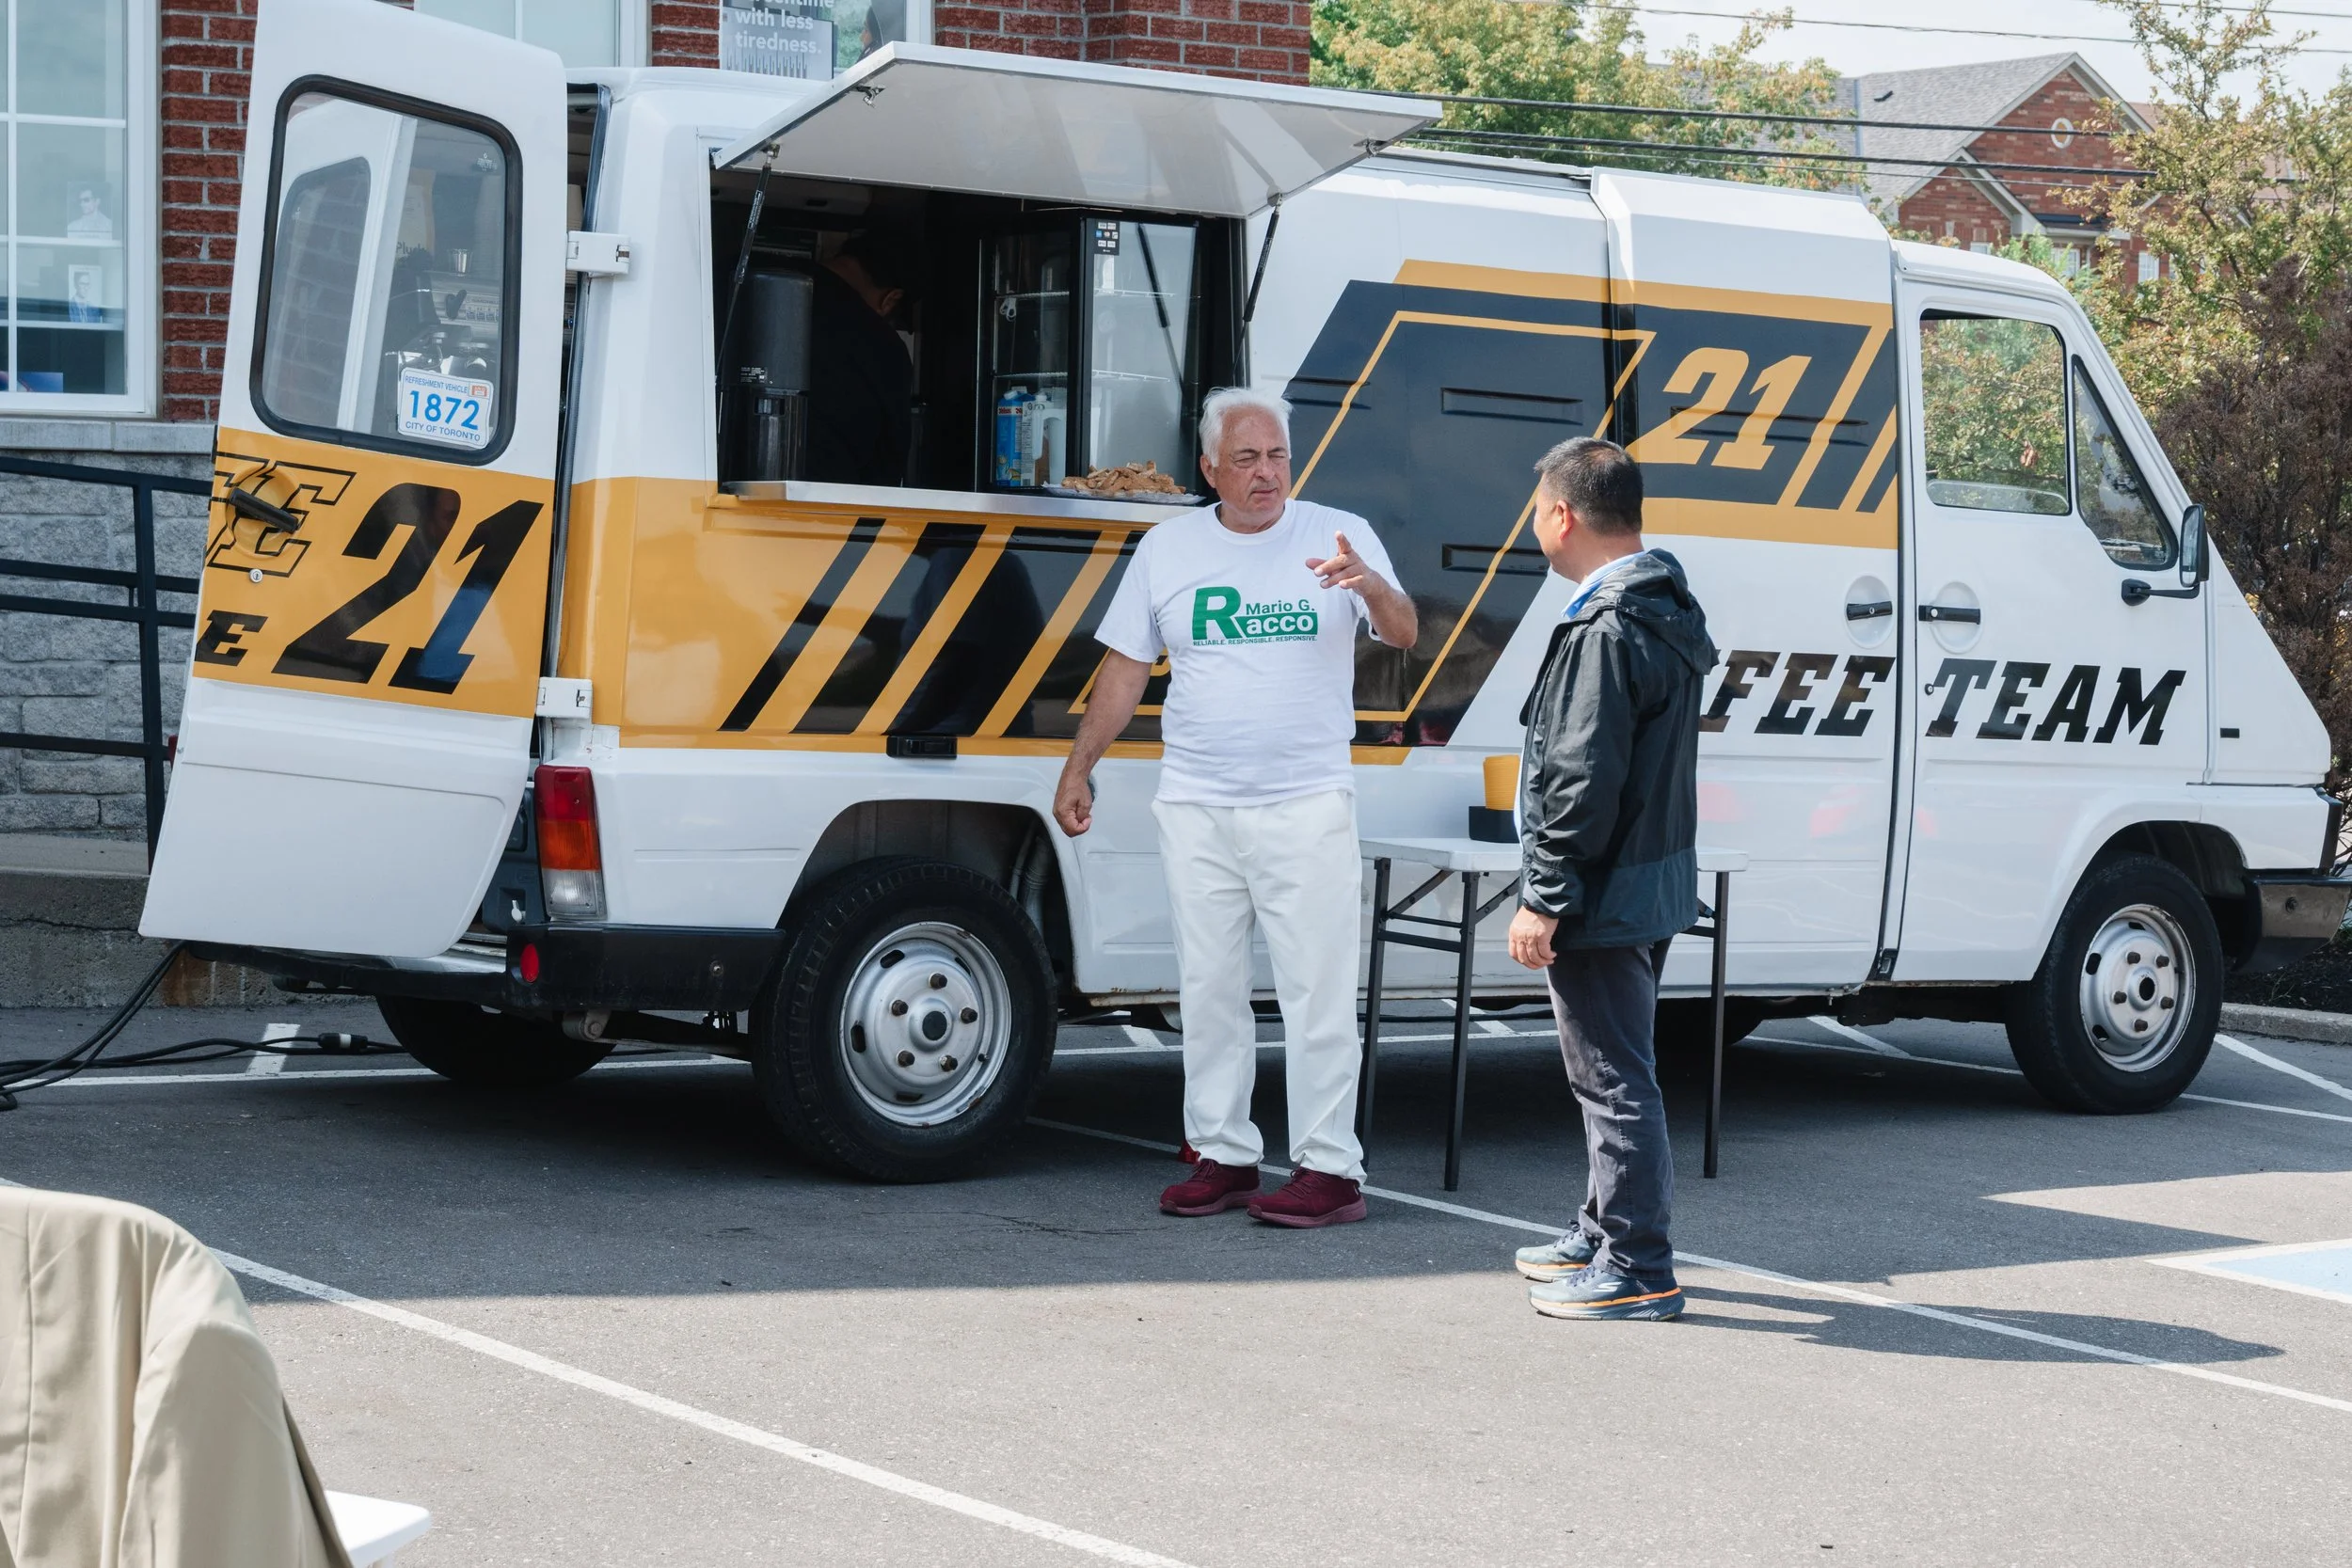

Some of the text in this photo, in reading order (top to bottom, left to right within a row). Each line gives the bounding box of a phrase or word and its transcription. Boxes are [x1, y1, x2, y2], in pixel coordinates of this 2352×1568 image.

[735, 8, 814, 29] with less
[735, 30, 822, 54] tiredness.
[405, 375, 444, 388] REFRESHMENT
[445, 383, 468, 394] VEHICLE
[410, 390, 480, 430] 1872
[1624, 347, 1813, 470] 21
[405, 421, 481, 441] CITY OF TORONTO
[271, 483, 544, 694] 21
[1246, 598, 1315, 615] Mario G.
[1699, 648, 2186, 745] FEE TEAM
